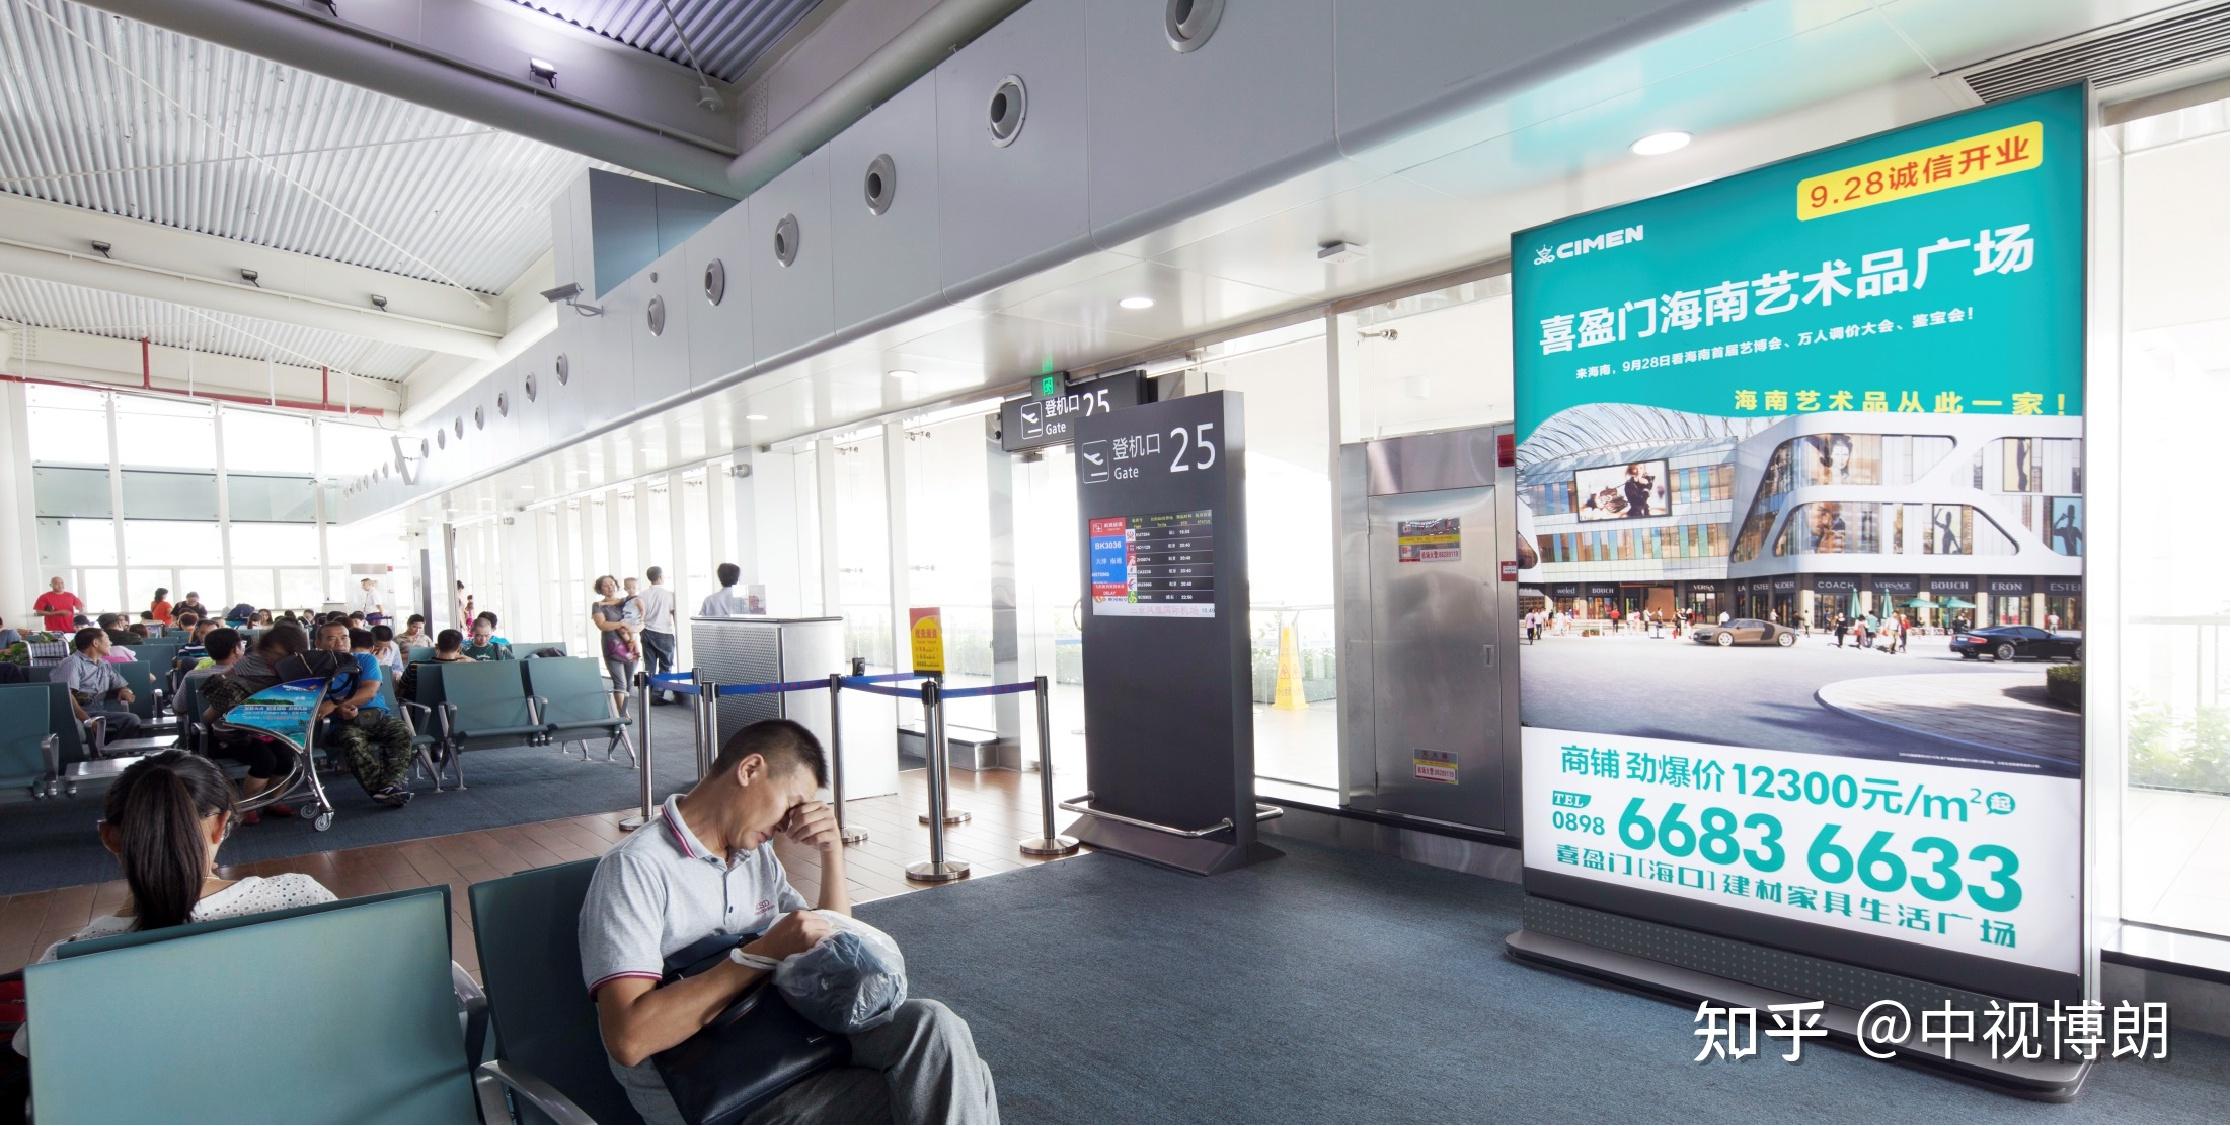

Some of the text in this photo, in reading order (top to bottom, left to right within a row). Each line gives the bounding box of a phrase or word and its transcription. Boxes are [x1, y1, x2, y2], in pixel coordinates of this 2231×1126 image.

[1809, 135, 2030, 209] 9.28诚信开业
[1556, 224, 1644, 259] CIMEN
[1539, 223, 2034, 355] 喜盈门海南艺术品广场
[1045, 396, 1080, 418] 登机口
[1735, 389, 2067, 415] 海南艺术品从此一家！
[1046, 423, 1066, 435] Gate
[1112, 423, 1216, 473] 登机口 25
[1115, 467, 1139, 480] Gate
[1818, 581, 1854, 589] COACH
[1931, 581, 1969, 590] BOUCH
[1992, 582, 2023, 591] ERON
[1560, 747, 1620, 780] 商铺
[1554, 793, 1584, 807] TEL
[1552, 797, 2023, 913] 0898 6683 6633
